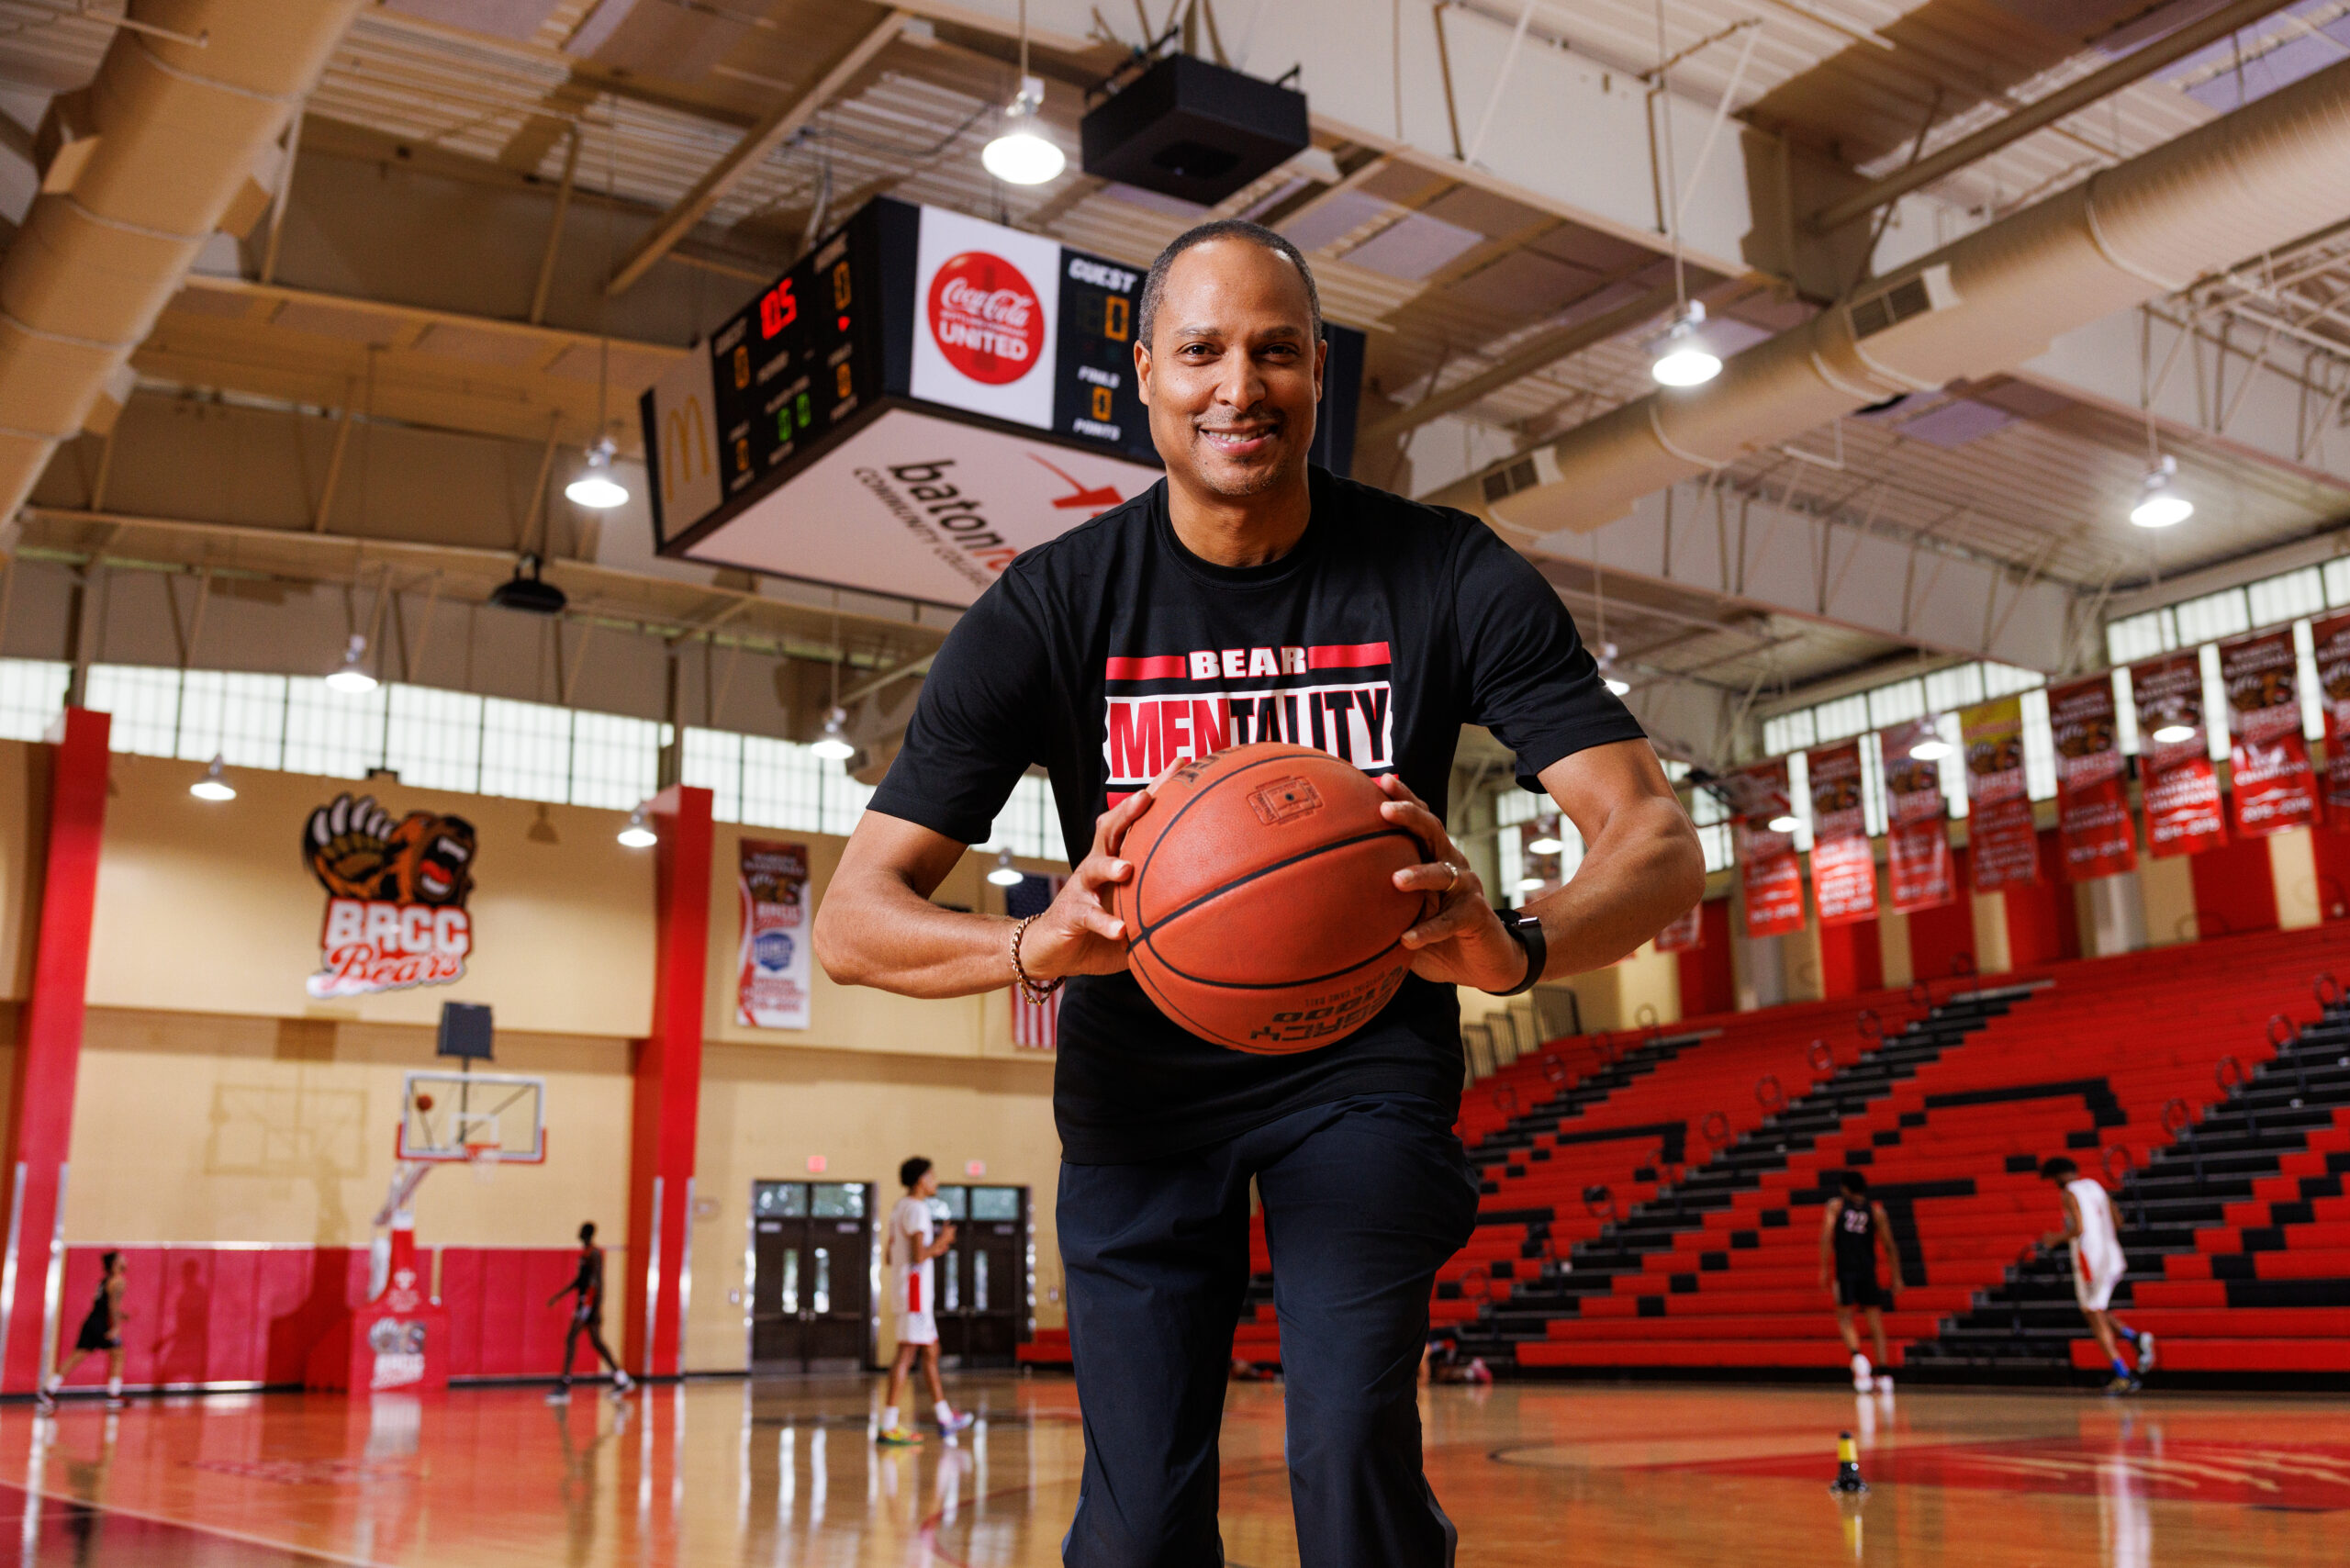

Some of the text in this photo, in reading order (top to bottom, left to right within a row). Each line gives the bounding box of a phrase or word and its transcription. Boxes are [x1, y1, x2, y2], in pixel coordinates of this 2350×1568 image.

[1069, 259, 1137, 293] GUEST
[940, 276, 1034, 328] Coca-Cola
[1104, 295, 1130, 342] 0
[938, 320, 1029, 361] UNITED
[1190, 646, 1306, 680] BEAR
[325, 900, 468, 955] BRCC
[318, 943, 458, 991] Bears
[1844, 1210, 1869, 1233] 22
